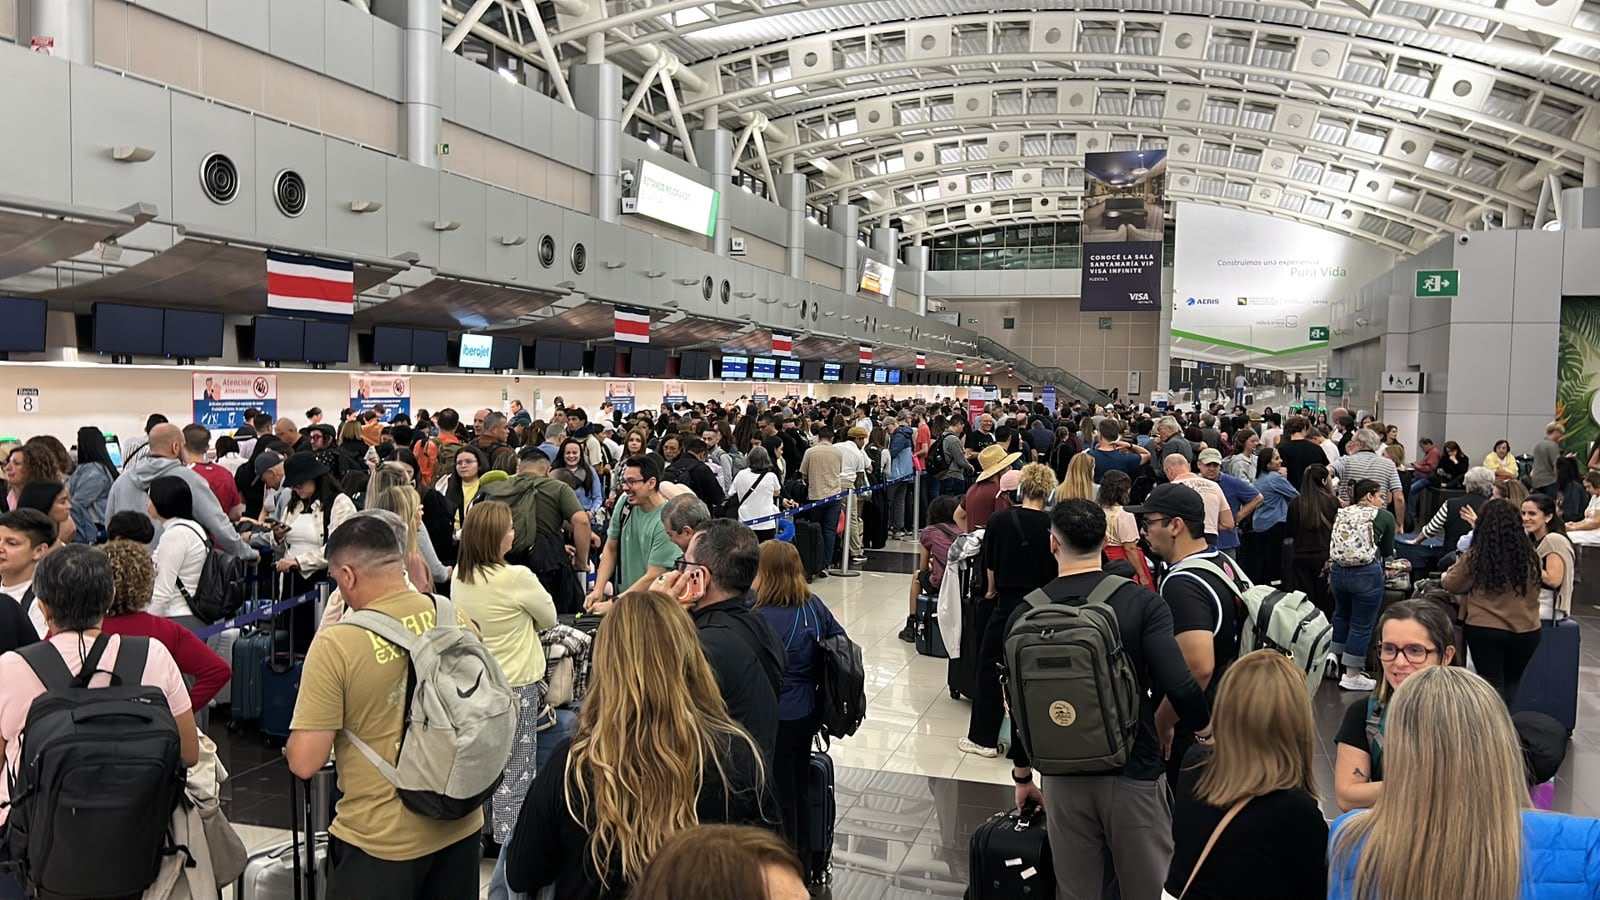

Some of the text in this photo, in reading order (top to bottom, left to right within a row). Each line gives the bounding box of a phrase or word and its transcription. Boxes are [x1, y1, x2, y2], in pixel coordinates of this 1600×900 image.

[1217, 259, 1262, 267] Construimos
[1290, 266, 1347, 277] Pura Vida
[1128, 292, 1149, 300] VISA
[222, 378, 251, 386] Atención
[23, 396, 33, 411] 8
